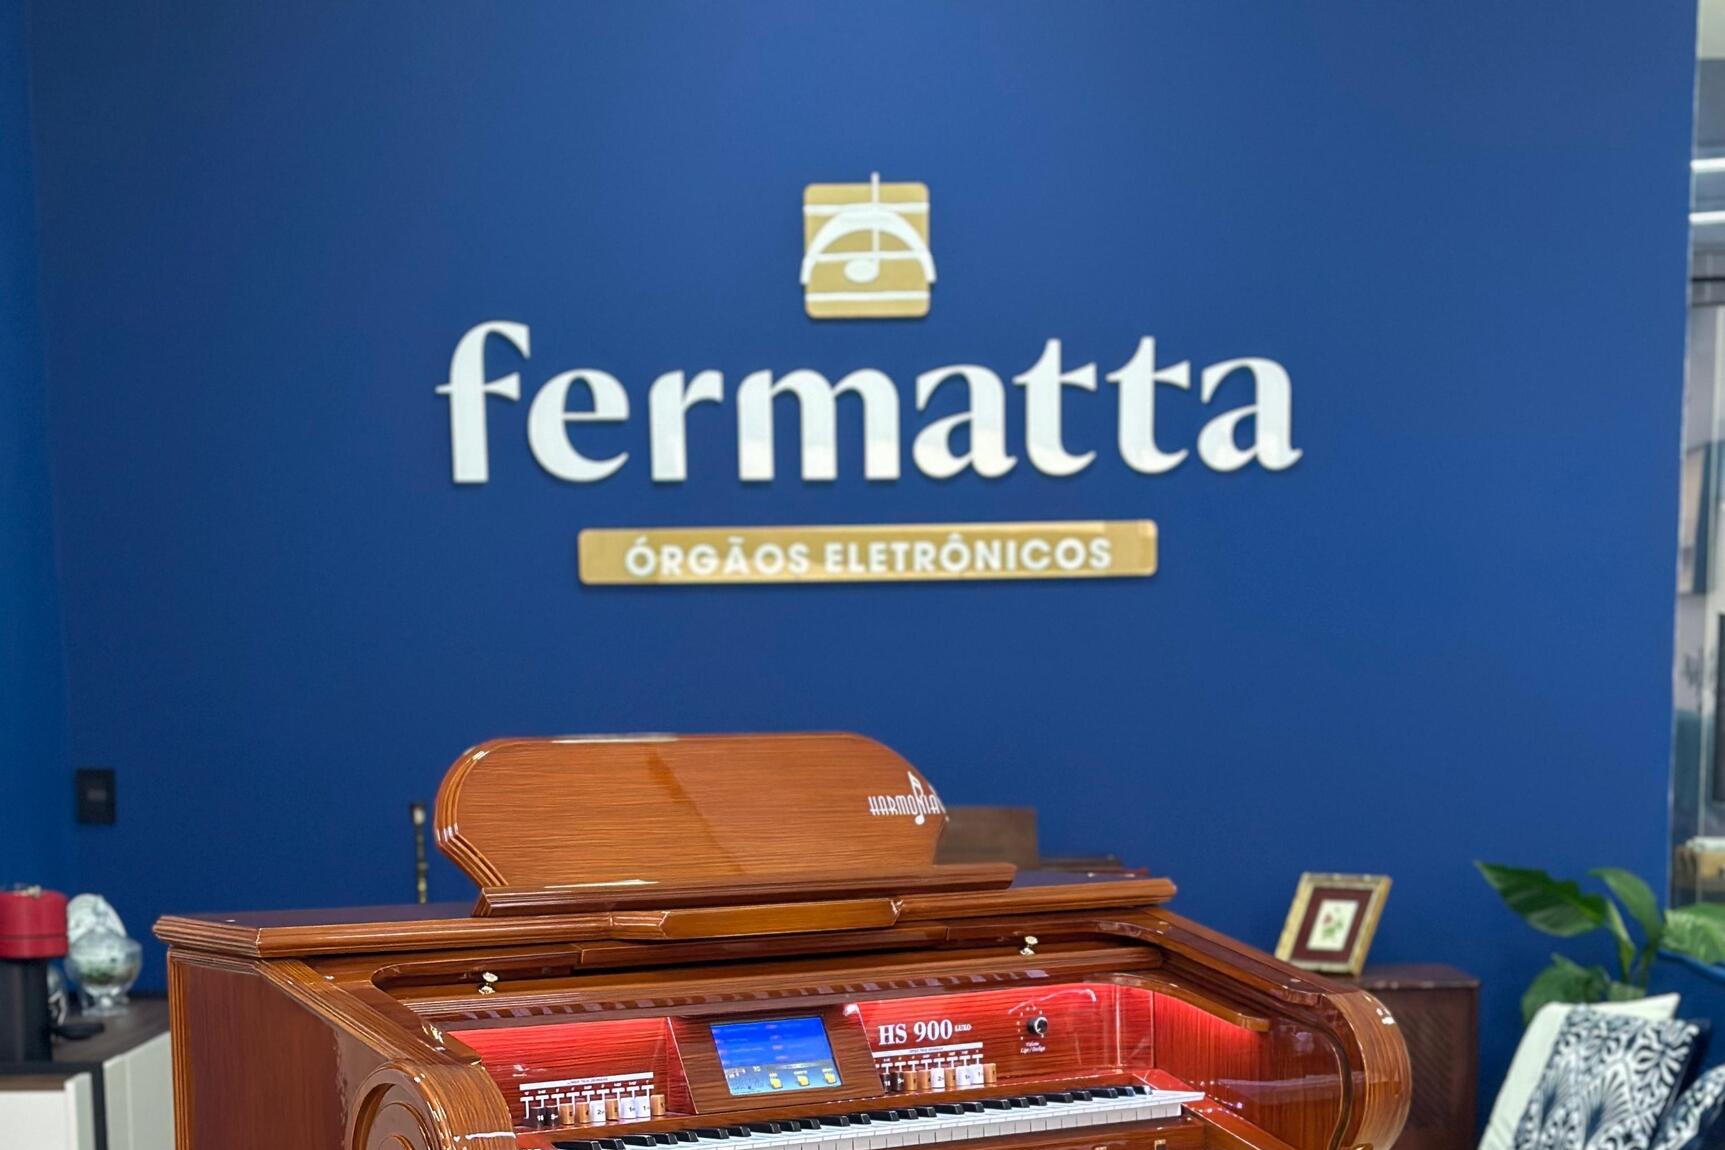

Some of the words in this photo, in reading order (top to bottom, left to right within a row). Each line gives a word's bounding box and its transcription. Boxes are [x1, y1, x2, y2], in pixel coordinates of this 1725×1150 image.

[436, 320, 1303, 483] fermatta
[625, 536, 811, 577] ÓRGÃOS
[824, 532, 1112, 573] ELETRÔNICOS
[867, 770, 941, 825] HARMONIA
[878, 1023, 908, 1046] HS
[913, 1019, 953, 1042] 900
